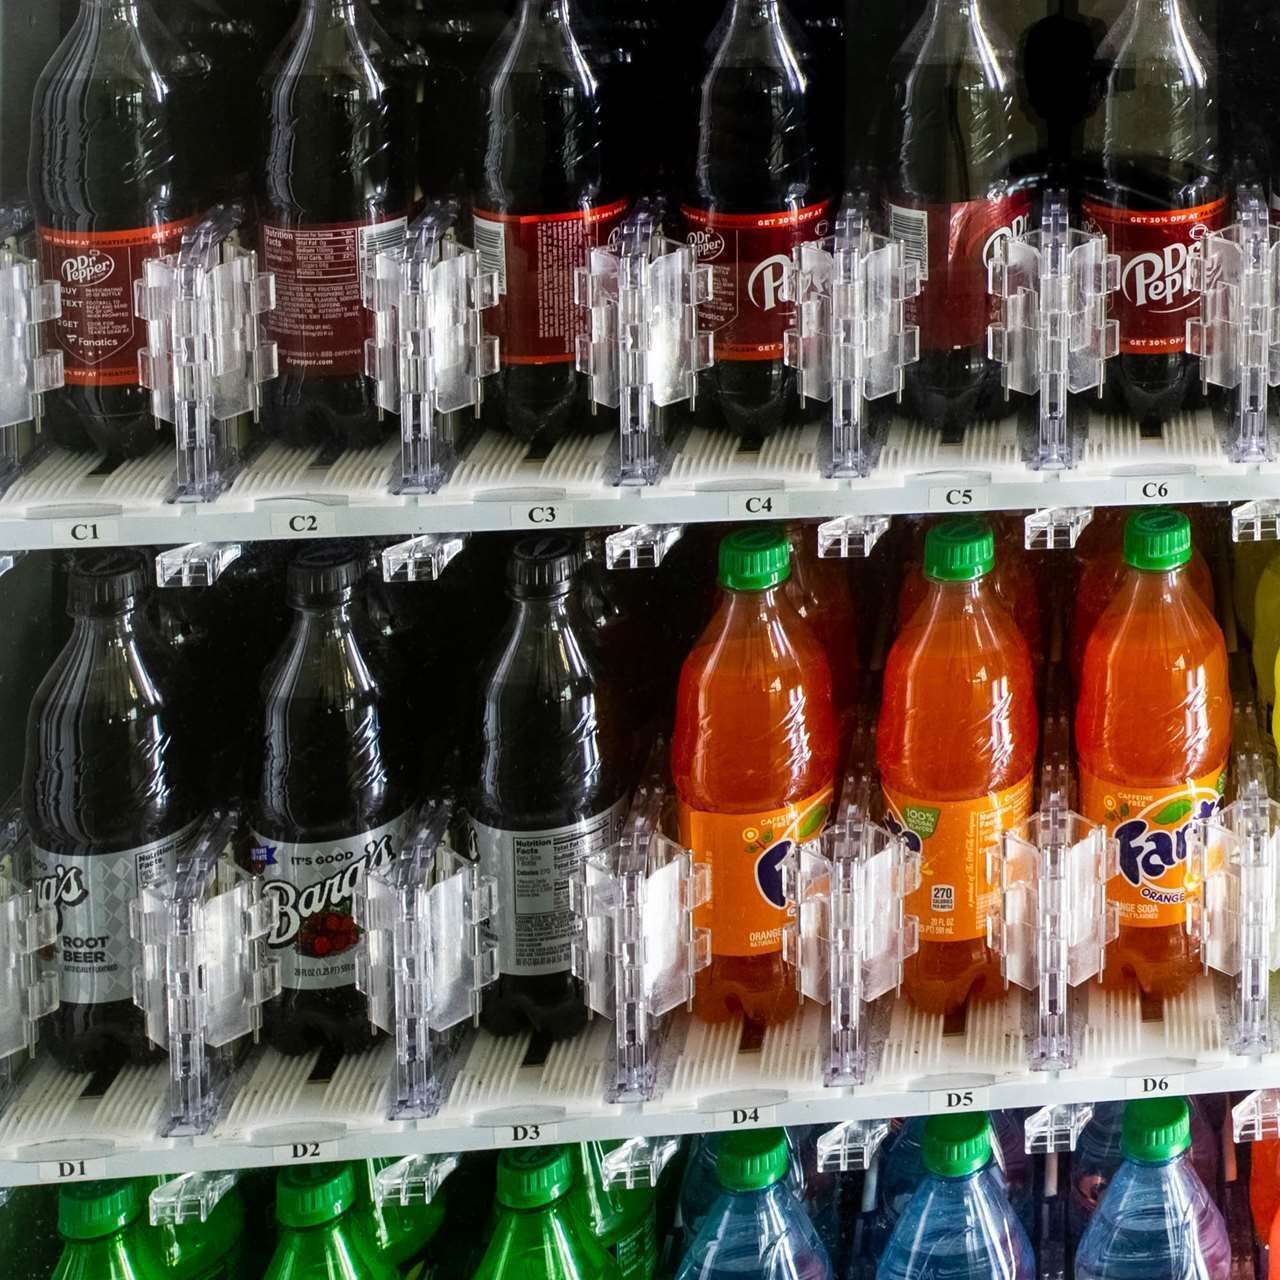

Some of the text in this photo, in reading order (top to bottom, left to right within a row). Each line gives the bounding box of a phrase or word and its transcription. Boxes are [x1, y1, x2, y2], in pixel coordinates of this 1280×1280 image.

[64, 257, 111, 283] Pepper
[79, 255, 97, 269] Dr
[78, 337, 118, 346] Fanatics
[945, 489, 973, 505] C5
[1142, 482, 1168, 498] C6
[745, 497, 773, 513] C4
[528, 506, 556, 523] C3
[288, 515, 318, 532] C2
[70, 523, 99, 541] C1
[291, 850, 354, 866] IT'S GOOD
[933, 888, 952, 899] 270
[1142, 889, 1185, 903] ORANGE
[62, 935, 110, 949] ROOT
[62, 949, 106, 963] BEER
[1143, 1077, 1169, 1092] D6
[947, 1091, 973, 1108] D5
[732, 1107, 760, 1124] D4
[511, 1124, 540, 1141] D3
[292, 1141, 321, 1158] D2
[58, 1160, 86, 1177] D1
